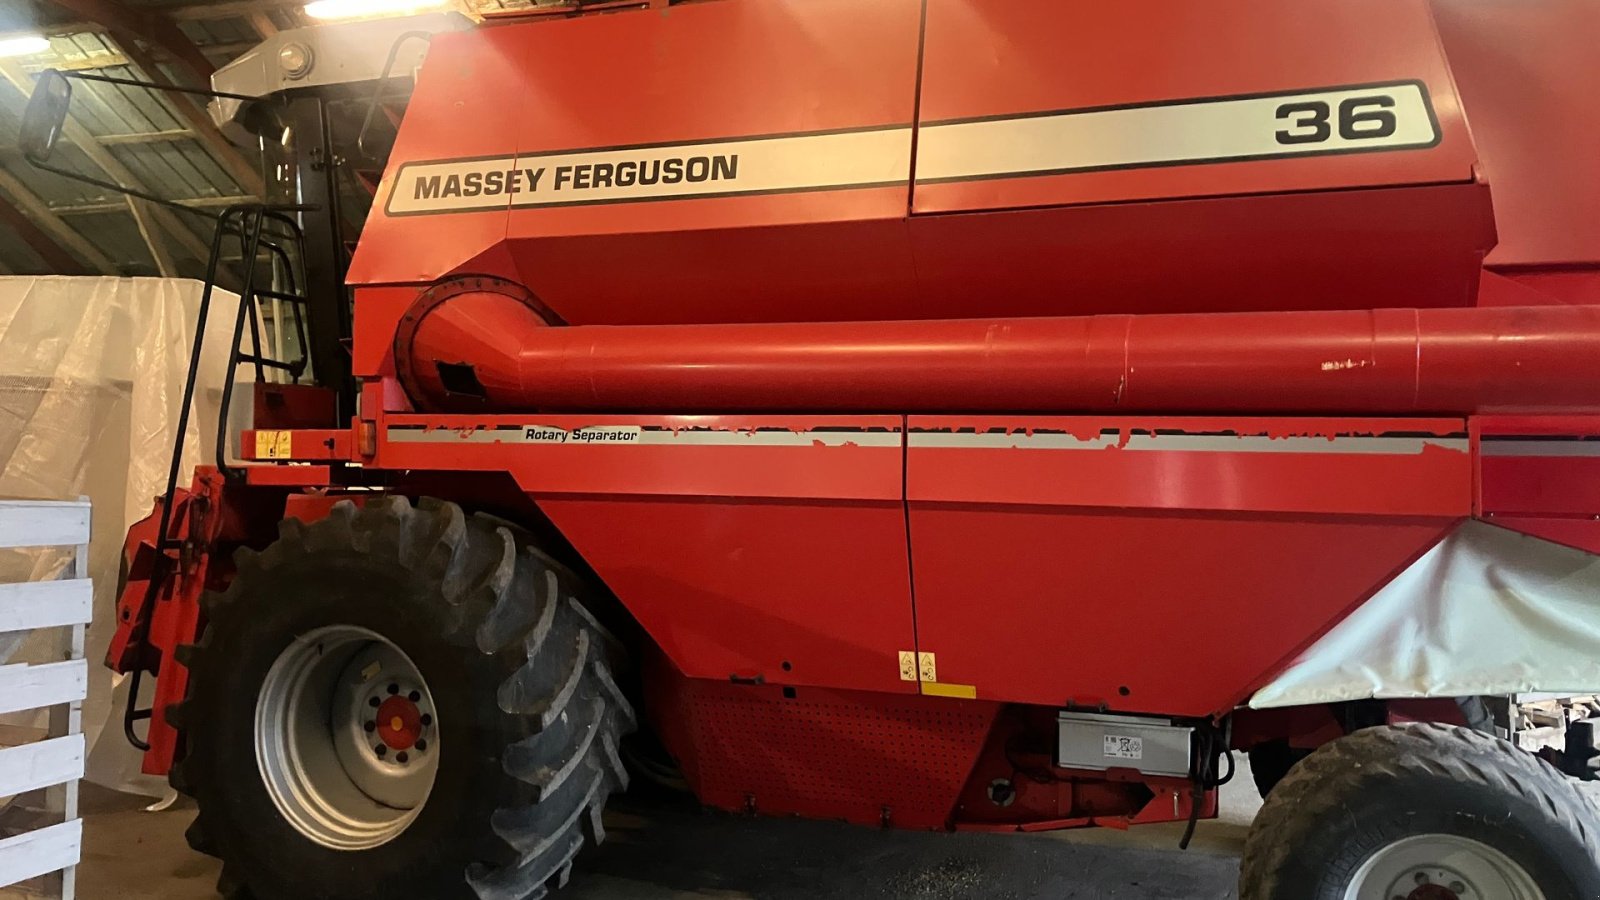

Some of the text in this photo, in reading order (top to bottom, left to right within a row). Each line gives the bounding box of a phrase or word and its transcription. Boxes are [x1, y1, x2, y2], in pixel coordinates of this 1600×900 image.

[1275, 94, 1397, 145] 36
[413, 154, 739, 200] MASSEY FERGUSON
[525, 428, 638, 443] Rotary Separator
